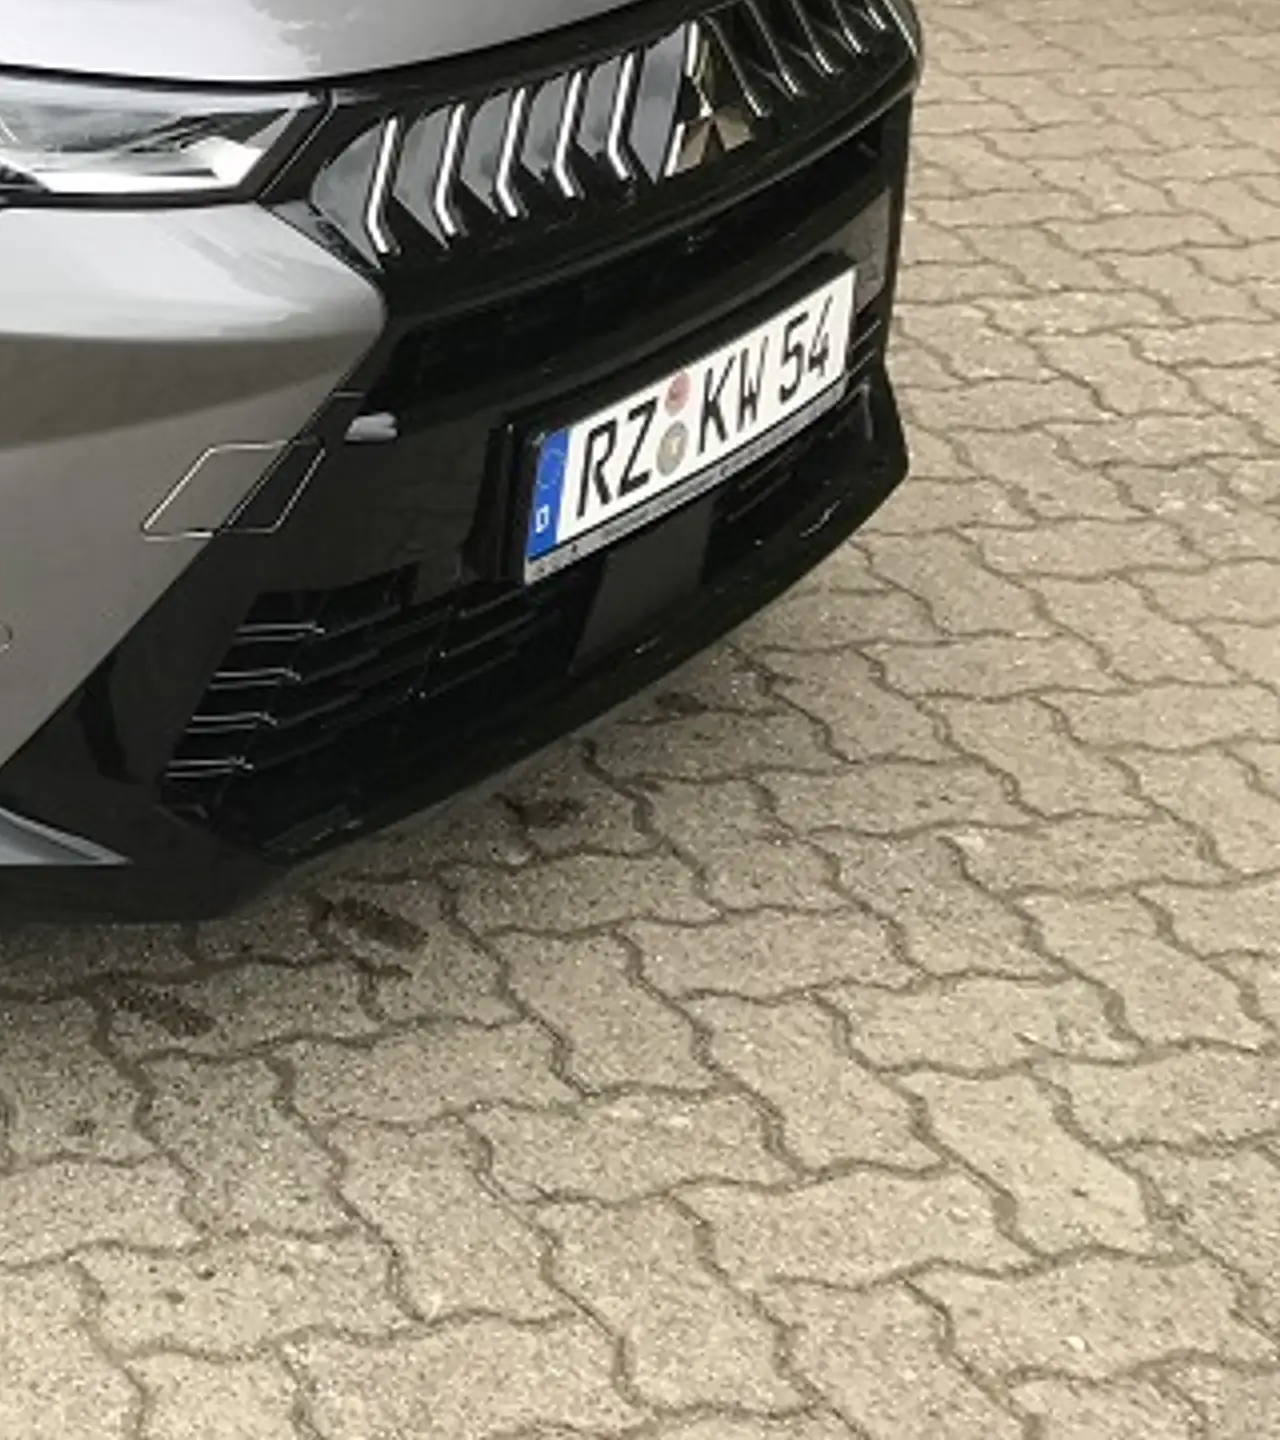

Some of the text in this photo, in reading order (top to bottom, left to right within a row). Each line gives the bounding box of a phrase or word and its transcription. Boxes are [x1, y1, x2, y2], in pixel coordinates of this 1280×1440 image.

[576, 396, 659, 517] RZ
[697, 336, 769, 456] KW
[778, 295, 833, 405] 54
